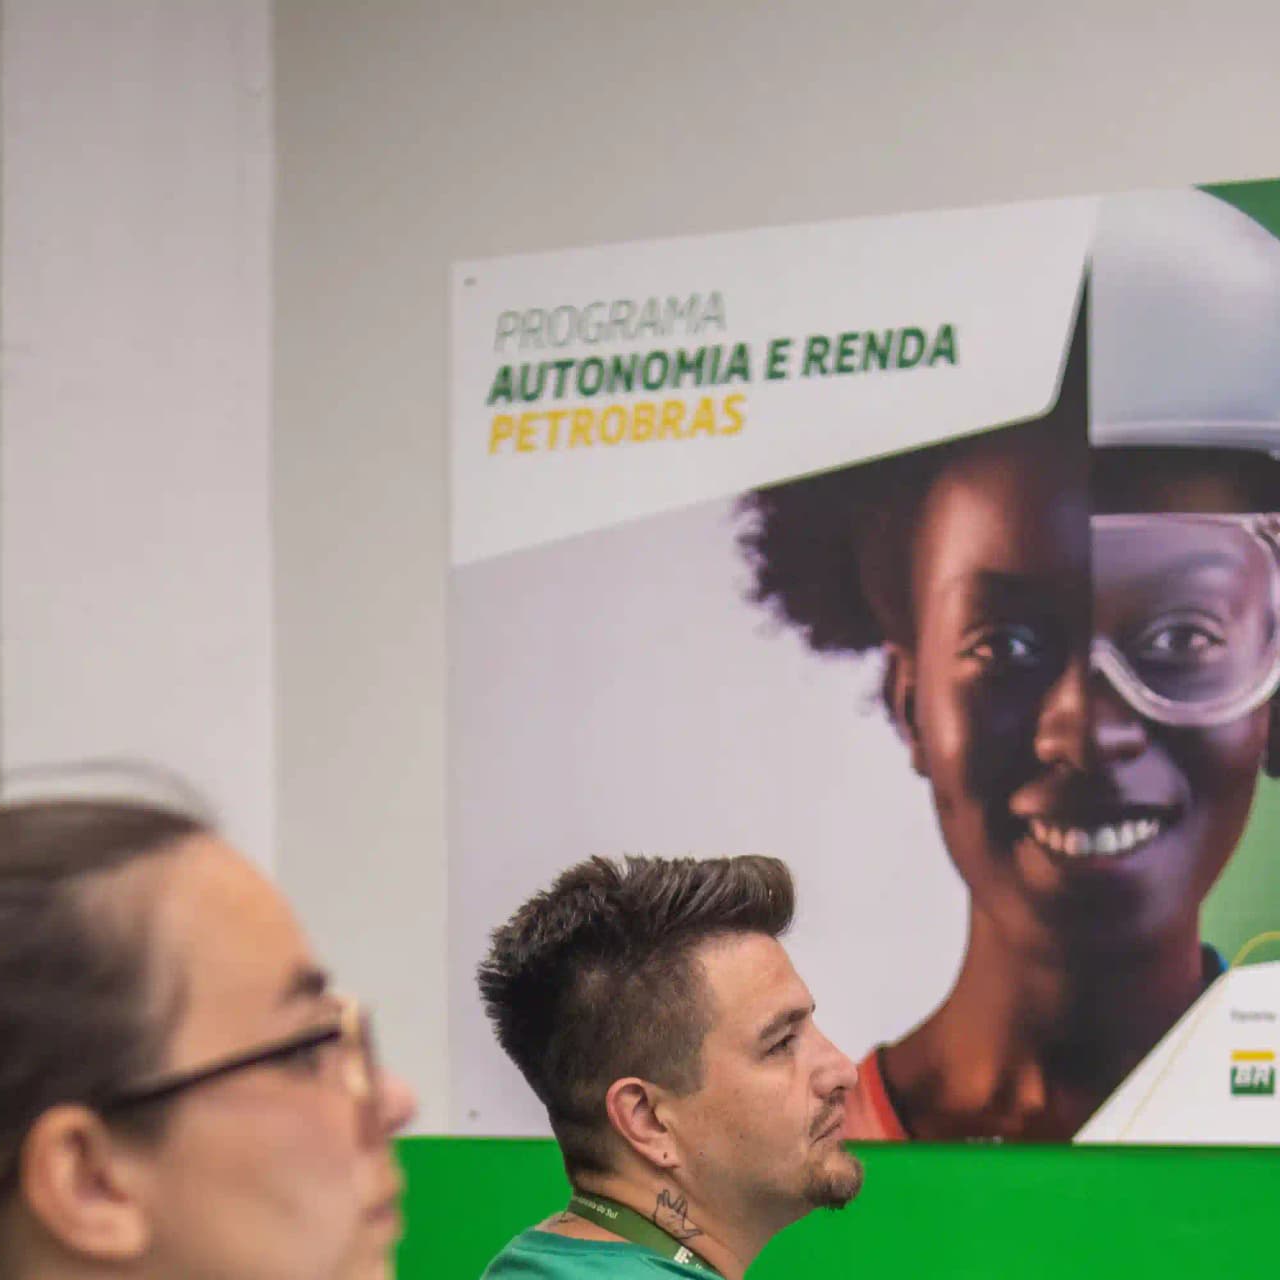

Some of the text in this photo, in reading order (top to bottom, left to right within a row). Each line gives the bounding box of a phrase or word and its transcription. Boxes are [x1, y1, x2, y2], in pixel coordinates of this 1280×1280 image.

[494, 291, 726, 352] PROGRAMA
[486, 324, 959, 406] AUTONOMIA E RENDA
[487, 394, 746, 455] PETROBRAS
